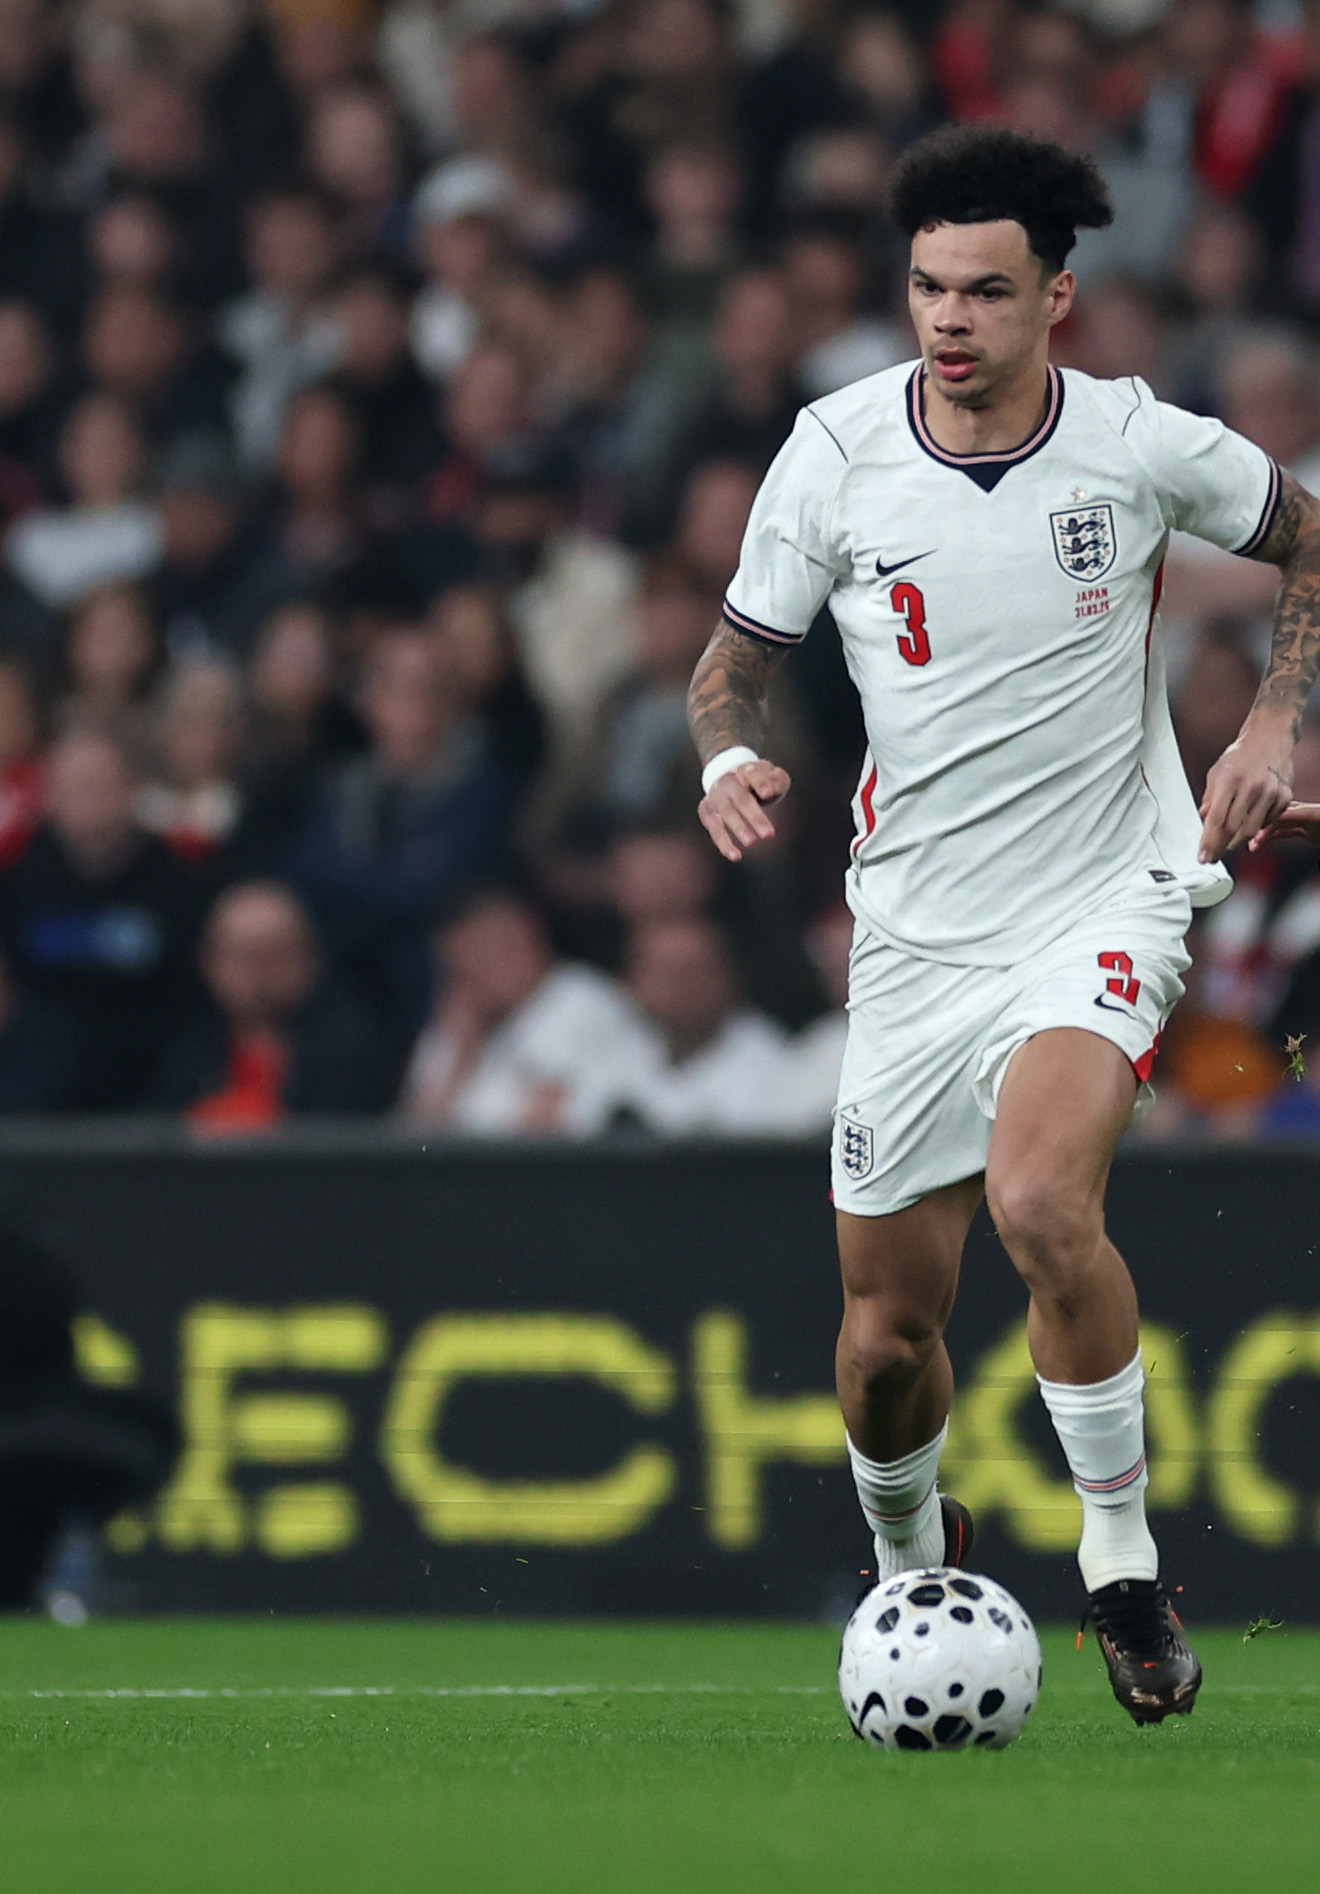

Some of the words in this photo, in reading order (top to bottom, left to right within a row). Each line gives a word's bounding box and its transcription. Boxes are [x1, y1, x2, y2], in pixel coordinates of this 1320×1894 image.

[1075, 587, 1109, 603] JAPAN
[890, 582, 932, 667] 3
[1097, 951, 1141, 1006] 3
